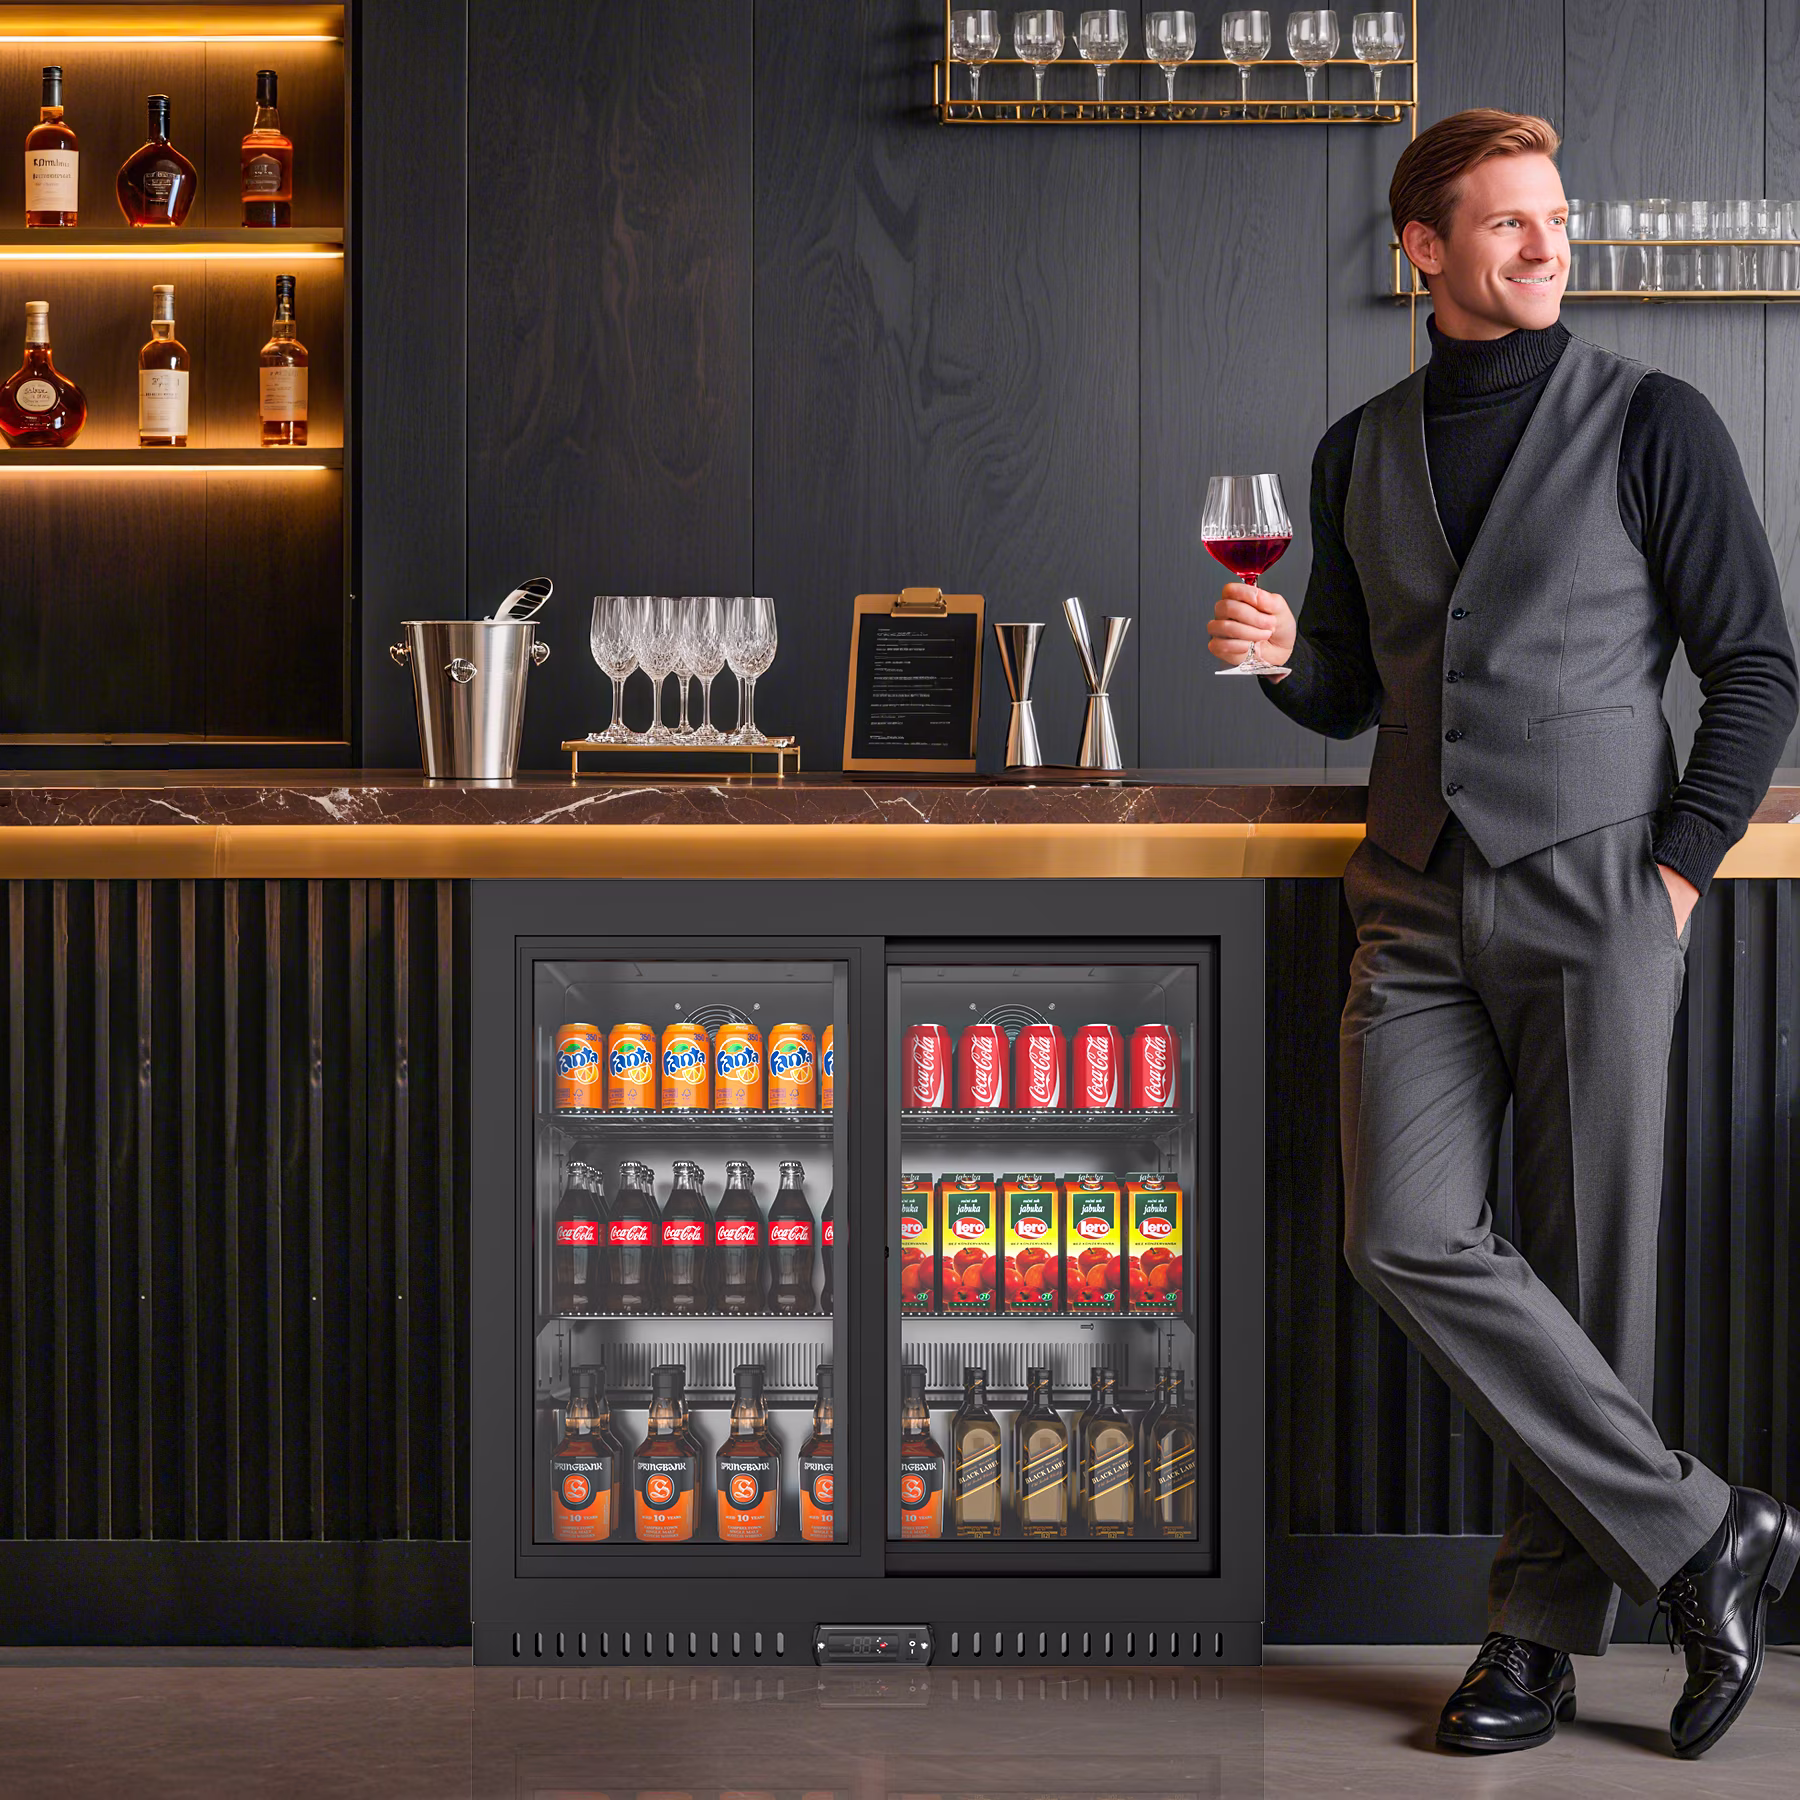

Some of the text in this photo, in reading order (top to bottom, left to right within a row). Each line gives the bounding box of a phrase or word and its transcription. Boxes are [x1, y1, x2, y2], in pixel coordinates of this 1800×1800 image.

[956, 1204, 980, 1215] jabuka
[1018, 1204, 1043, 1215] jabuka
[1081, 1204, 1105, 1215] jabuka
[1143, 1204, 1167, 1215] jabuka
[902, 1222, 921, 1233] ero
[955, 1220, 984, 1234] Lero
[1018, 1220, 1046, 1234] Lero
[1080, 1220, 1109, 1234] Lero
[1143, 1220, 1171, 1234] Lero
[570, 1514, 582, 1522] 10
[653, 1514, 665, 1522] 10
[737, 1514, 749, 1522] 10
[821, 1514, 833, 1522] 10
[905, 1514, 917, 1522] 10
